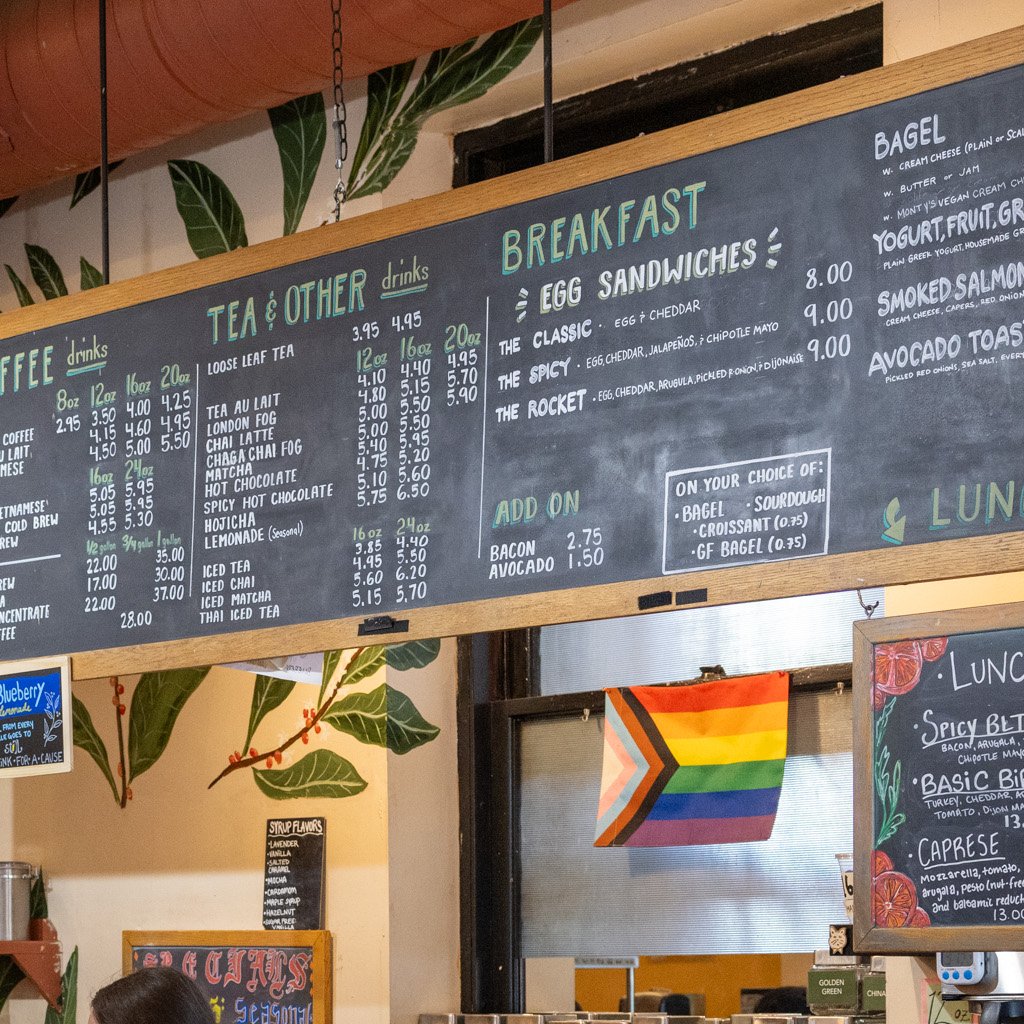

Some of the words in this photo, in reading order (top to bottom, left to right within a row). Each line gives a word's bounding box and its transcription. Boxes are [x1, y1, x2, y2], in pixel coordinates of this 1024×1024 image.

[875, 113, 946, 160] BAGEL
[899, 156, 928, 170] CREAM
[930, 147, 961, 163] CHEESE
[900, 177, 936, 193] BUTTER
[959, 165, 980, 177] JAM
[502, 181, 706, 275] BREAKFAST
[540, 277, 582, 314] EGG
[598, 239, 757, 300] SANDWICHES
[806, 261, 853, 290] 8.00
[207, 297, 257, 345] TEA
[284, 269, 367, 325] OTHER
[382, 256, 429, 289] drinks
[878, 277, 951, 317] SMOKED
[353, 322, 379, 342] 3.95
[392, 311, 421, 332] 4.95
[499, 337, 521, 356] THE
[533, 319, 592, 349] CLASSIC
[614, 314, 636, 328] EGG
[649, 299, 700, 321] CHEDDAR
[804, 298, 853, 327] 9.00
[67, 335, 108, 365] drinks
[208, 357, 237, 375] LOOSE
[242, 350, 267, 368] LEAF
[272, 344, 294, 361] TEA
[868, 334, 961, 377] AVOCADO
[498, 370, 521, 391] THE
[529, 357, 571, 384] SPICY
[56, 415, 80, 433] 2.95
[92, 407, 116, 426] 3.50
[126, 399, 151, 418] 4.00
[162, 390, 191, 412] 4.25
[496, 403, 519, 422] THE
[528, 388, 587, 418] ROCKET
[3, 428, 34, 445] COFFEE
[207, 416, 249, 437] LONDON
[255, 411, 277, 428] FOG
[8, 445, 30, 460] LAIT
[207, 449, 245, 469] CHAGA
[249, 443, 276, 462] CHAI
[281, 439, 302, 456] FOG
[205, 479, 227, 498] HOT
[234, 469, 297, 493] CHOCOLATE
[206, 463, 252, 483] MATCHA
[676, 482, 696, 497] ON
[703, 473, 740, 492] YOUR
[748, 467, 793, 485] CHOICE
[800, 461, 824, 477] OF:
[204, 499, 235, 515] SPICY
[243, 494, 264, 509] HOT
[271, 484, 333, 505] CHOCOLATE
[492, 496, 538, 529] ADD
[547, 489, 580, 519] ON
[683, 505, 725, 523] BAGEL
[754, 489, 825, 512] SOURDOUGH
[5, 519, 27, 533] COLD
[33, 514, 58, 529] BREW
[205, 512, 255, 533] HOJICHA
[699, 518, 769, 538] CROISSANT
[205, 528, 264, 550] LEMONADE
[490, 540, 535, 562] BACON
[567, 528, 602, 550] 2.75
[697, 543, 713, 560] GF
[721, 537, 763, 557] BAGEL
[768, 534, 807, 553] (0.75)
[489, 557, 554, 580] AVOCADO
[568, 547, 604, 569] 1.50
[121, 611, 152, 628] 28.00
[200, 609, 223, 624] THAI
[230, 608, 252, 621] ICED
[259, 605, 280, 619] TEA
[18, 721, 34, 729] EVERY
[270, 821, 291, 834] SYRUP
[293, 819, 322, 833] FLAVORS
[918, 832, 999, 867] CAPRESE
